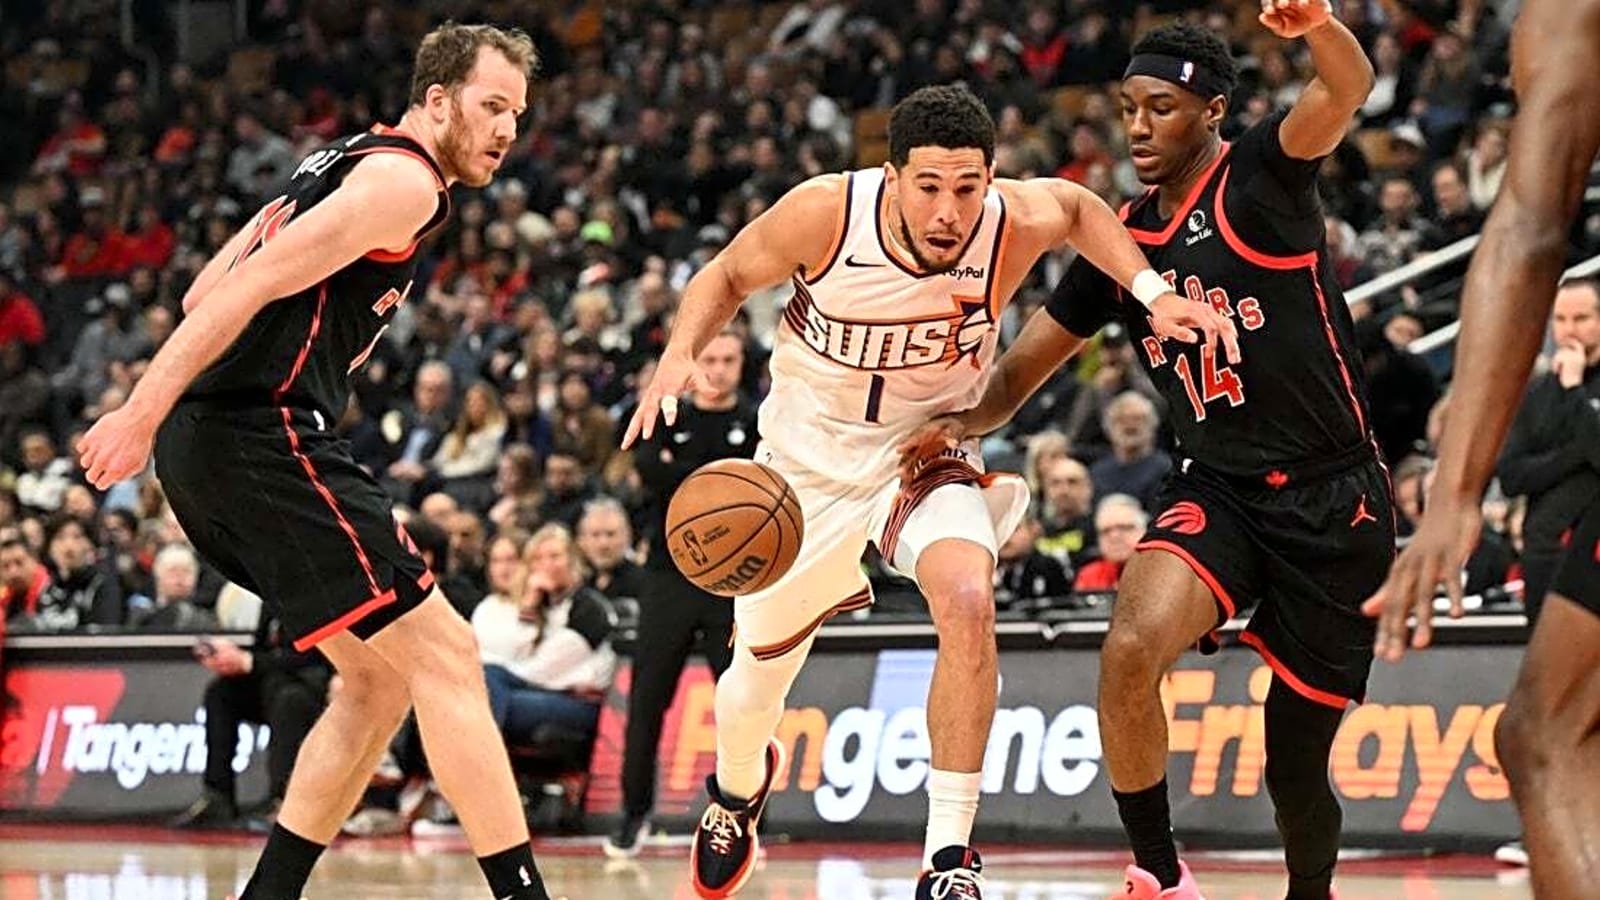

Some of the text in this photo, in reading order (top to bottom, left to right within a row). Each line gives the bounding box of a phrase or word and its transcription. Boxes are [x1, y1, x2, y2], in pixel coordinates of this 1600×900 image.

[943, 266, 984, 280] ayPal
[1142, 269, 1265, 368] RTORS
[864, 373, 885, 424] 1
[1174, 343, 1245, 422] 14
[1159, 665, 1511, 831] Friays
